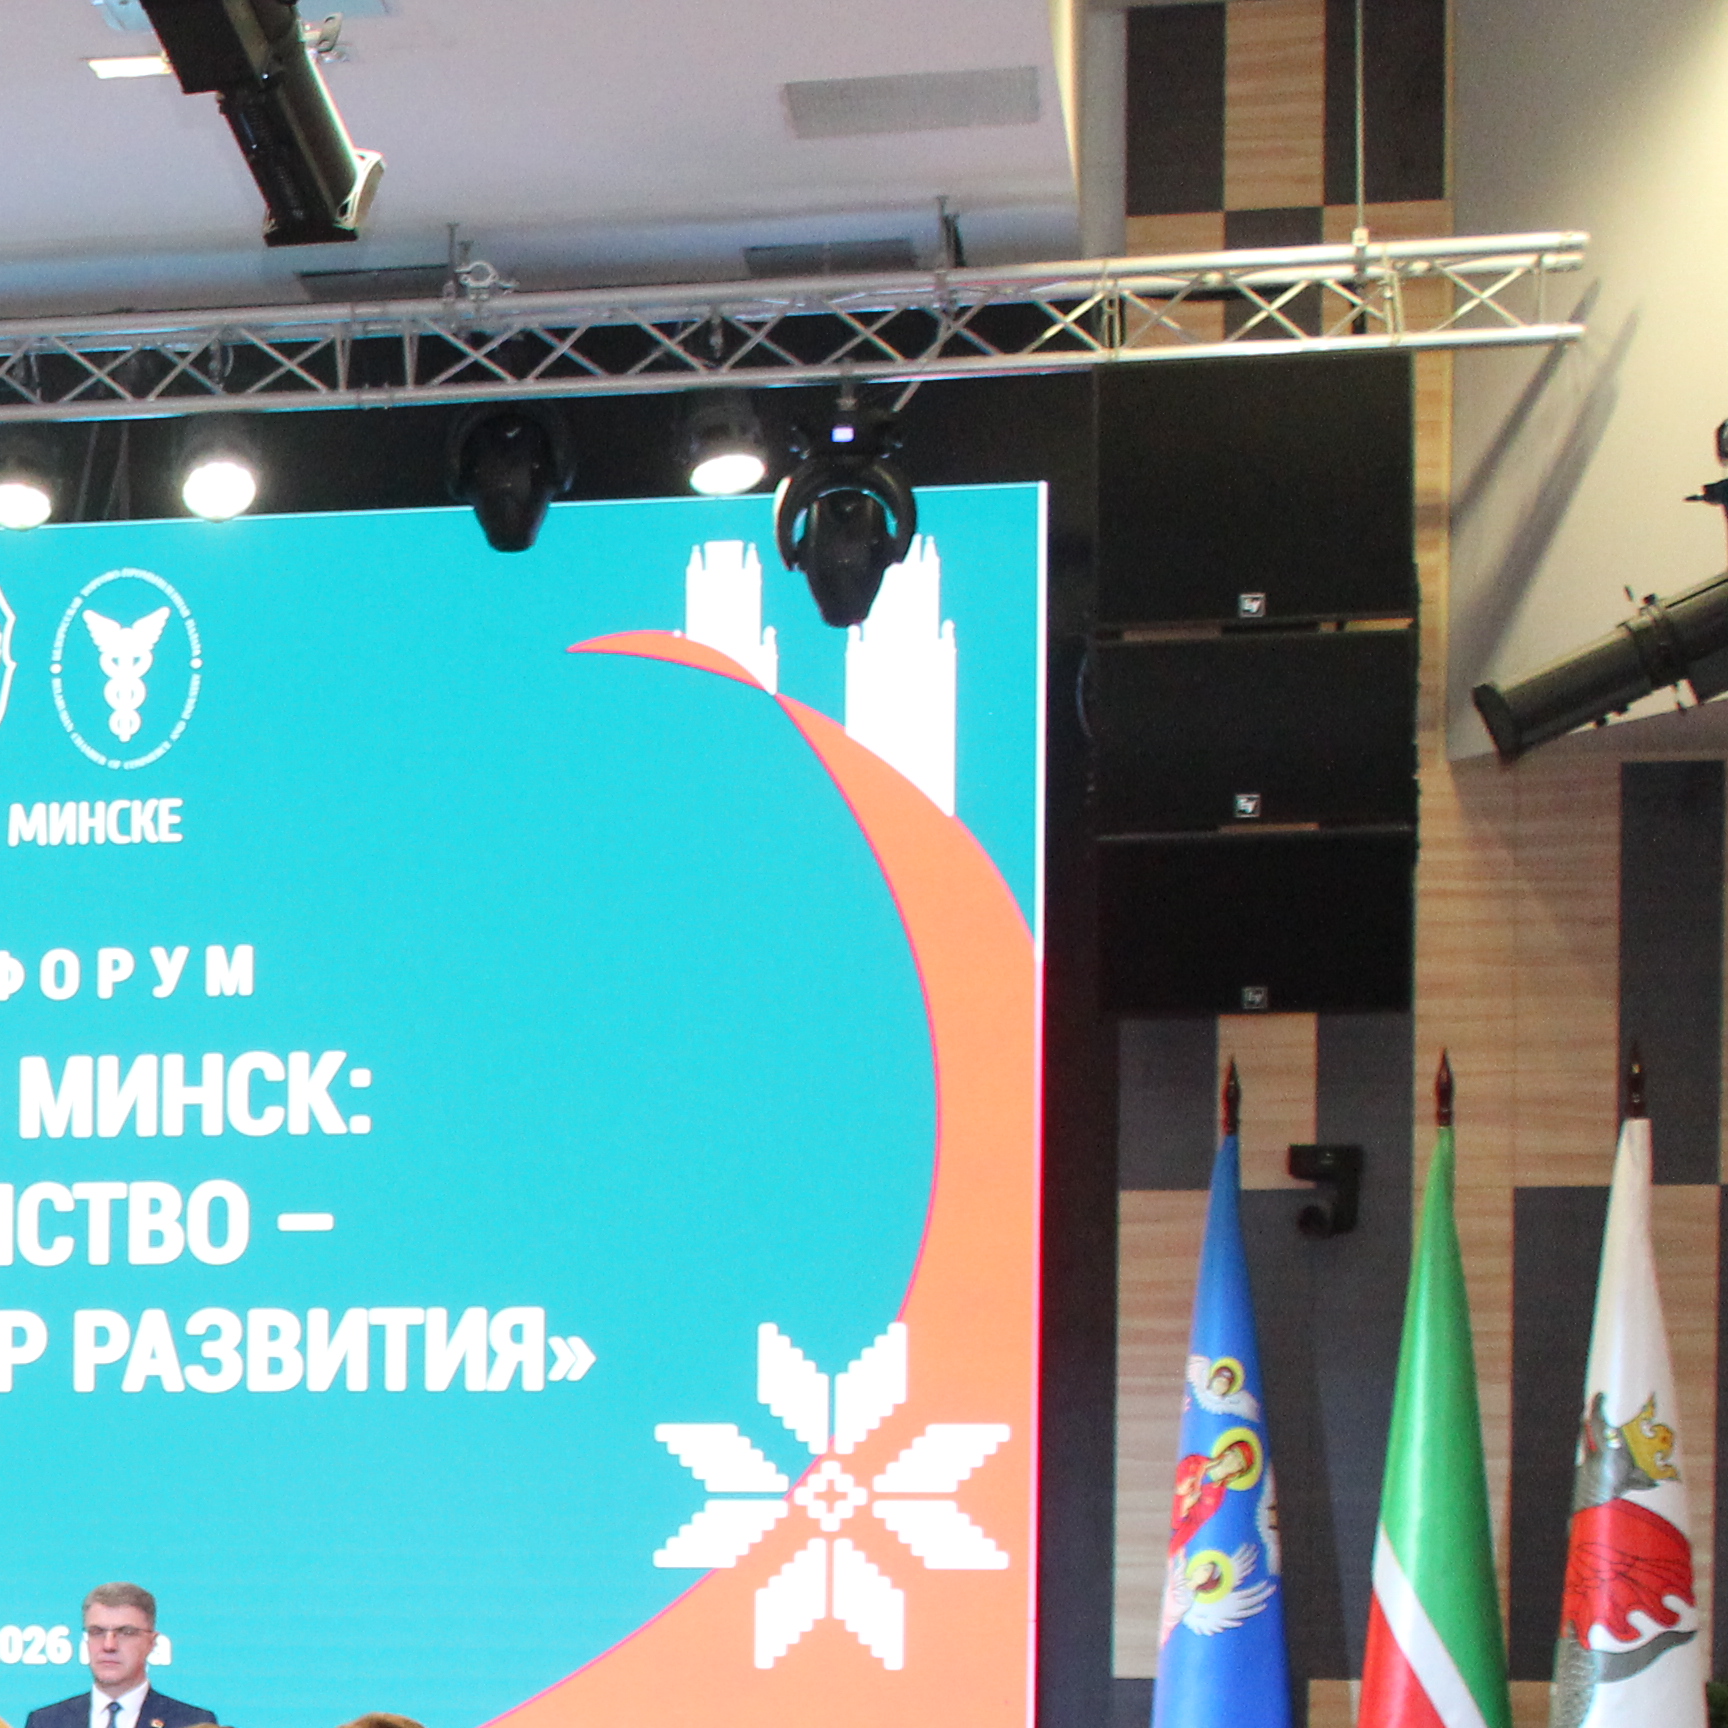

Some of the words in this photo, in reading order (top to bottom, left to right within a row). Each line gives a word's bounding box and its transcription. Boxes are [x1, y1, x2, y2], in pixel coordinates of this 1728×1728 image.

[7, 797, 185, 847] МИНСКЕ
[18, 1049, 374, 1141] МИНСК:
[72, 1305, 598, 1394] РАЗВИТИЯ»
